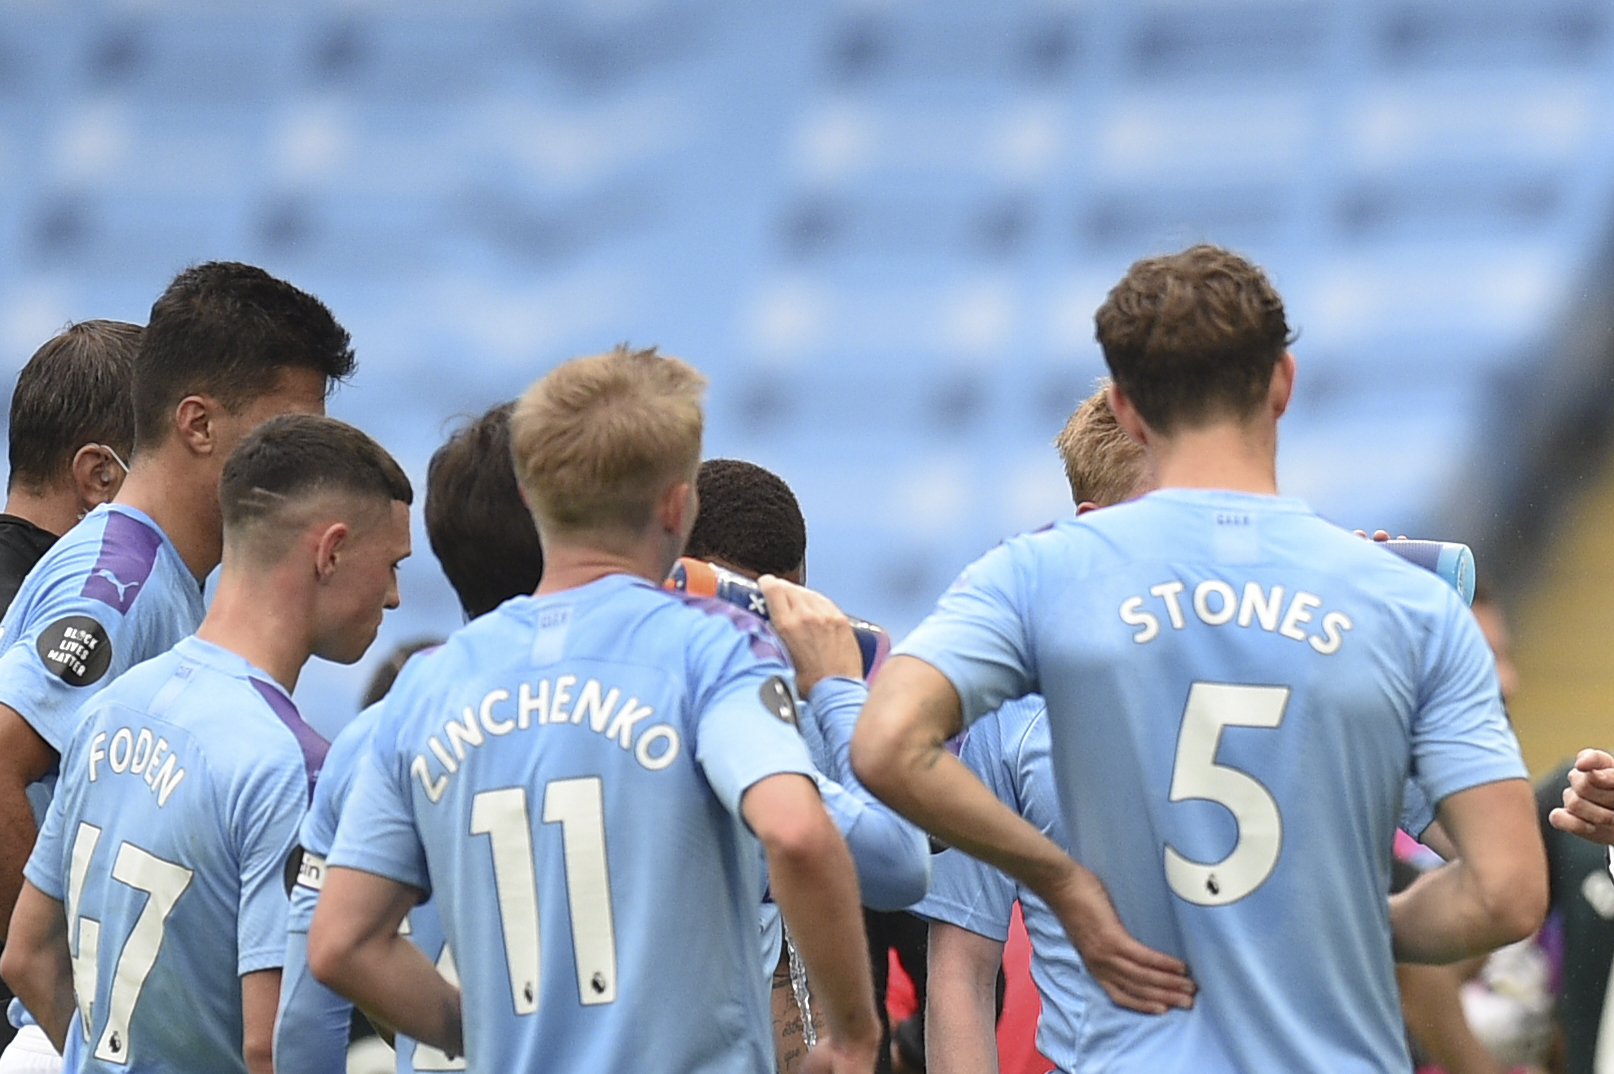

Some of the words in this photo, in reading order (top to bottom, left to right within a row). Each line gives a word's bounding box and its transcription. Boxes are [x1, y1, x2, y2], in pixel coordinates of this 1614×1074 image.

[47, 649, 87, 678] MATTER
[59, 639, 90, 661] LIVES
[1118, 579, 1353, 656] STONES
[88, 726, 187, 809] FODEN
[410, 673, 682, 805] ZINCHENKO
[1163, 679, 1292, 907] 5
[67, 821, 194, 1064] 47
[468, 776, 617, 1016] 11
